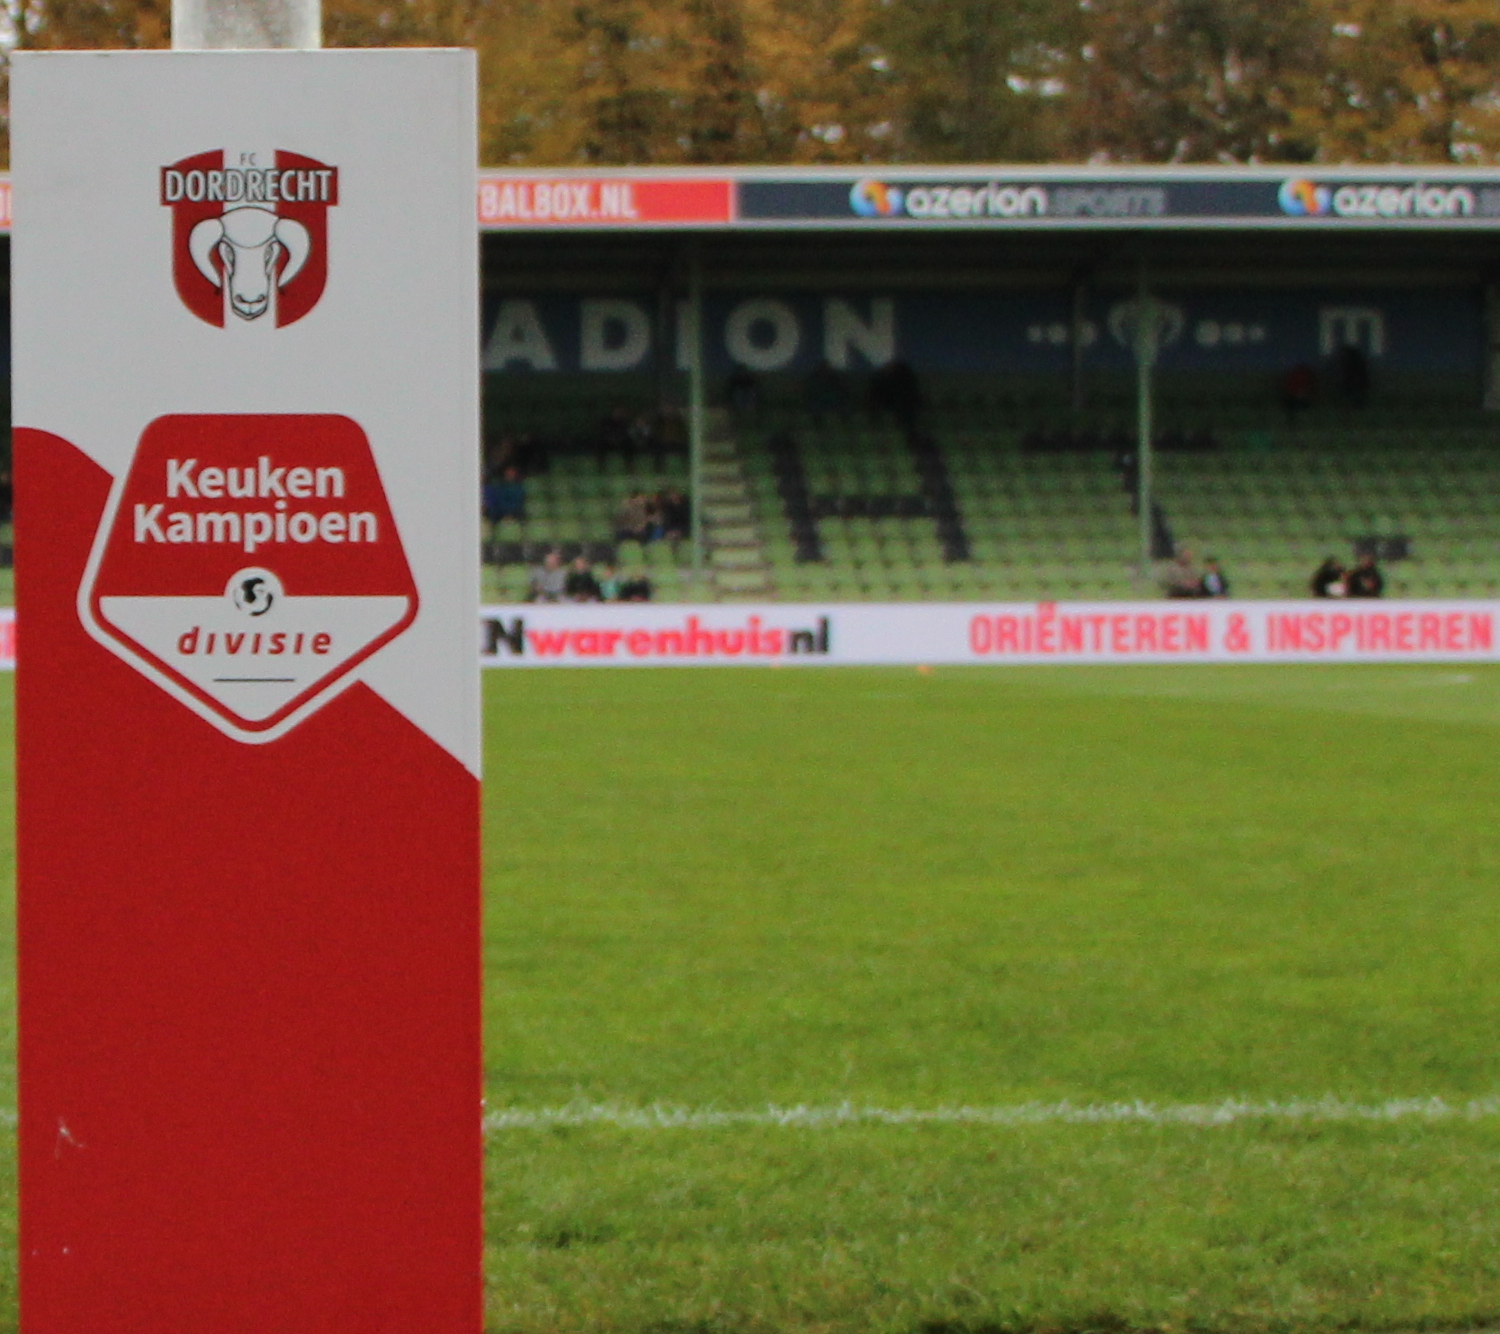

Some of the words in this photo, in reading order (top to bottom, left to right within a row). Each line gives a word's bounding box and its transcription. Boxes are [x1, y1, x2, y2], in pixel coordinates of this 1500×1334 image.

[240, 153, 256, 166] FC
[164, 169, 333, 202] DORDRECHT
[480, 183, 639, 219] BALBOX.NL
[905, 180, 1048, 218] azerion
[1333, 181, 1474, 218] azerion
[480, 297, 895, 371] ADION
[166, 455, 345, 498] Keuken
[133, 499, 378, 553] Kampioen
[177, 625, 332, 655] divisie
[969, 601, 1209, 655] ORIËNTEREN
[1223, 613, 1251, 652] &
[1266, 612, 1494, 651] INSPIREREN
